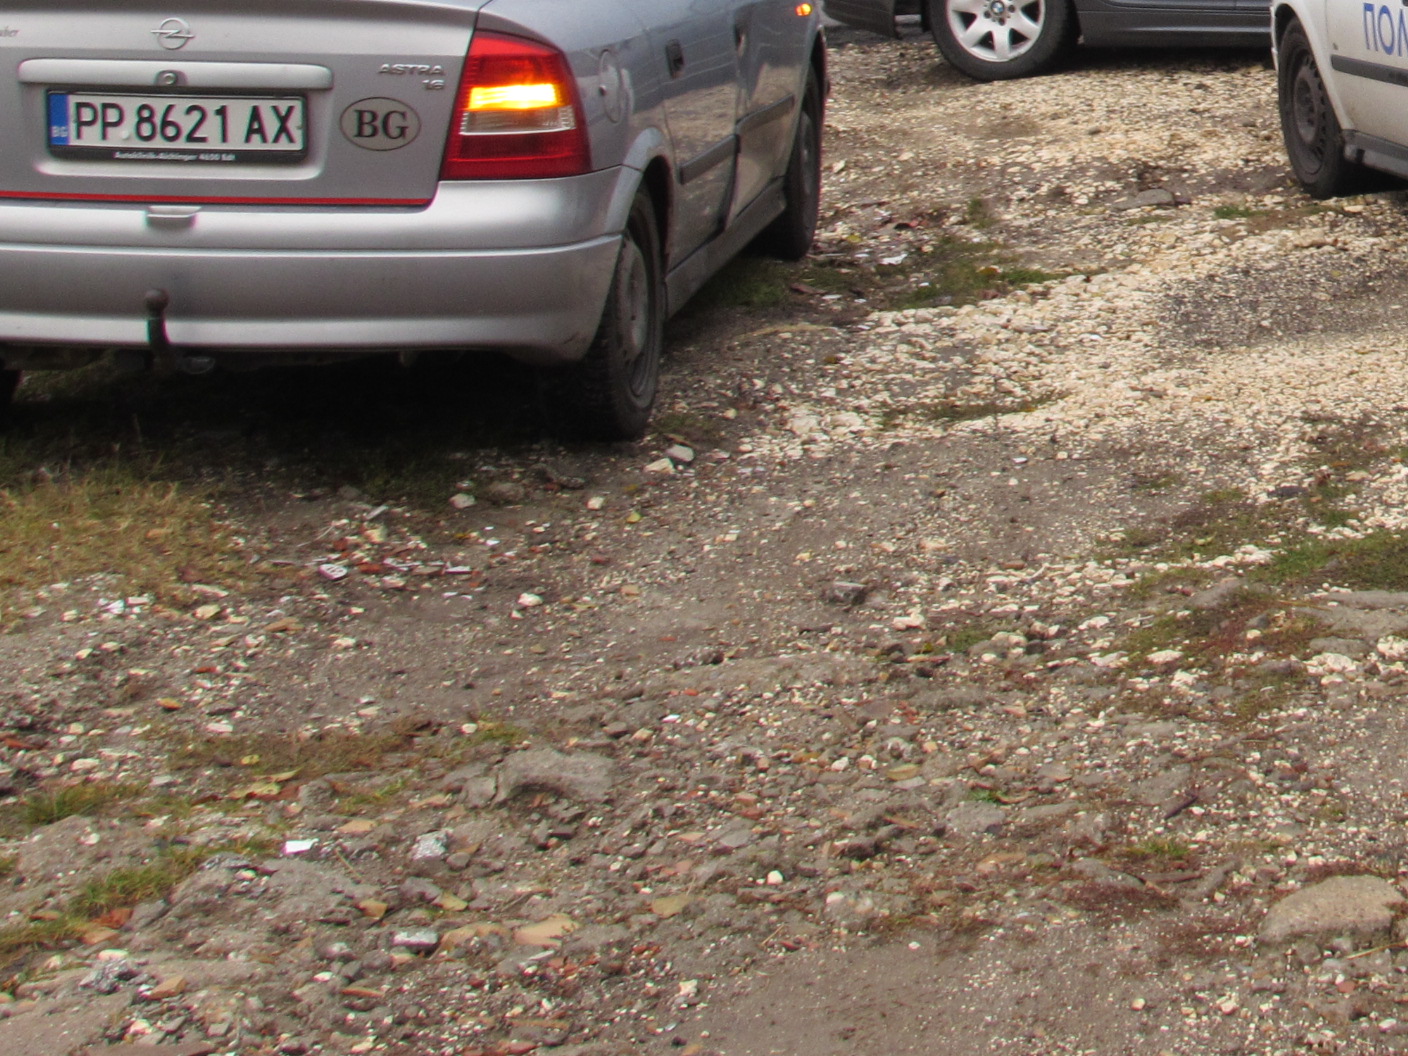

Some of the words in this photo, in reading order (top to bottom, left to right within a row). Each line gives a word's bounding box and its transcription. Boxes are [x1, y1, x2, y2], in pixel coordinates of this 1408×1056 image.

[378, 63, 444, 75] ASTRA
[74, 101, 125, 142] PP
[134, 103, 229, 144] 8621
[244, 105, 296, 145] AX
[353, 109, 409, 140] BG
